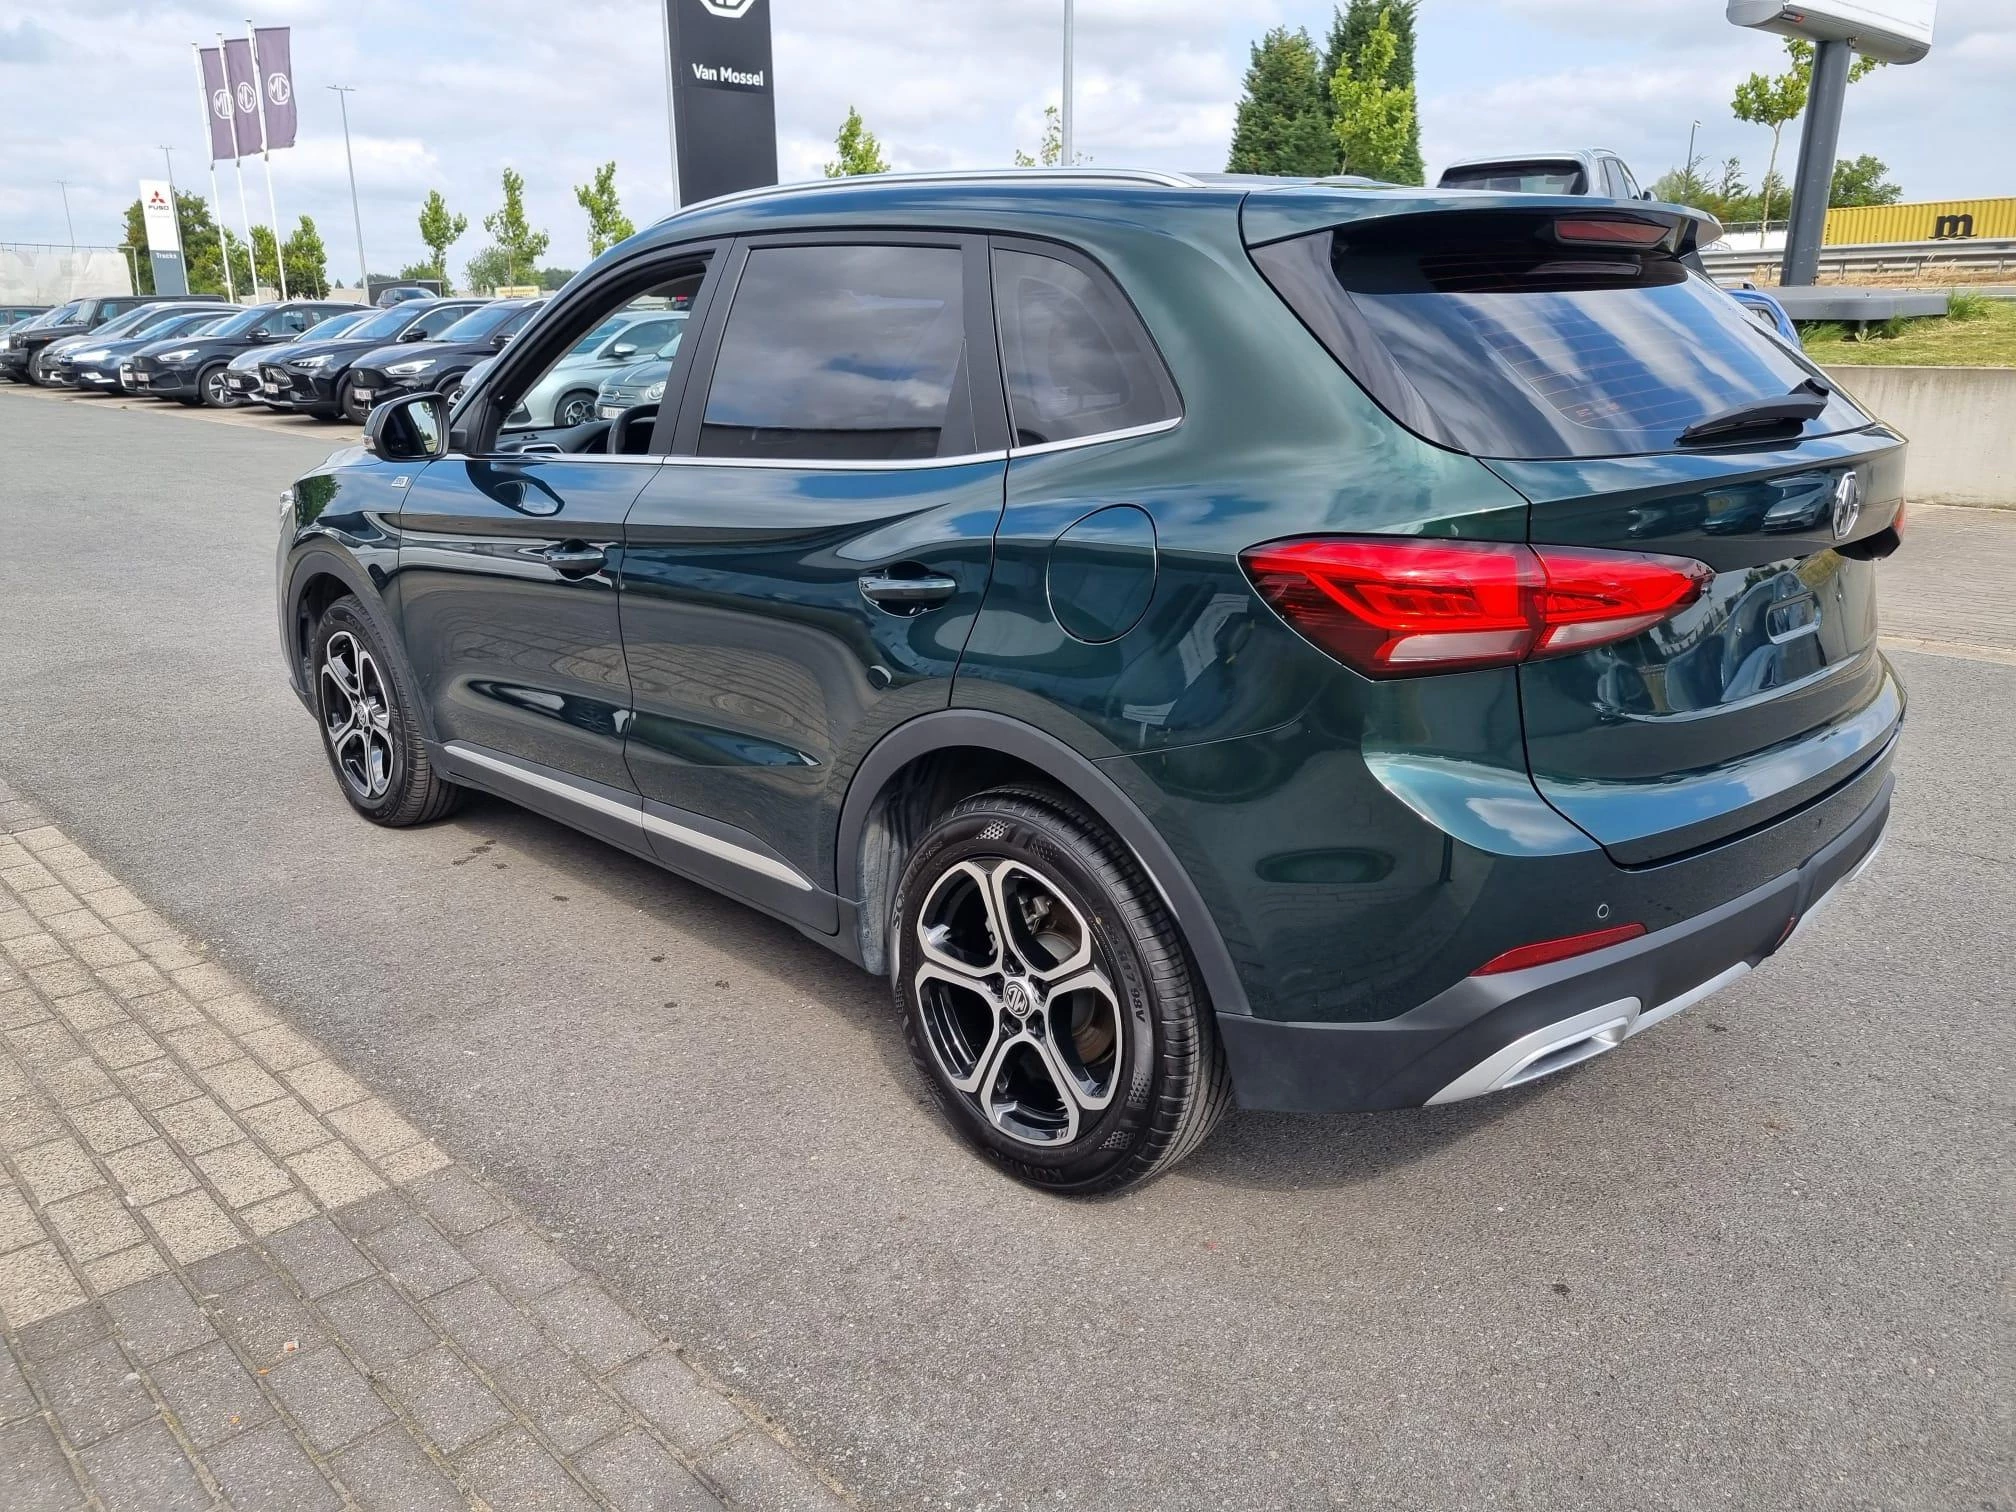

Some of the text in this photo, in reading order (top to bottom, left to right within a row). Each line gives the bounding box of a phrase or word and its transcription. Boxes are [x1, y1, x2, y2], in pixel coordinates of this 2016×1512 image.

[692, 63, 764, 86] Van Mossel
[268, 75, 288, 103] MG
